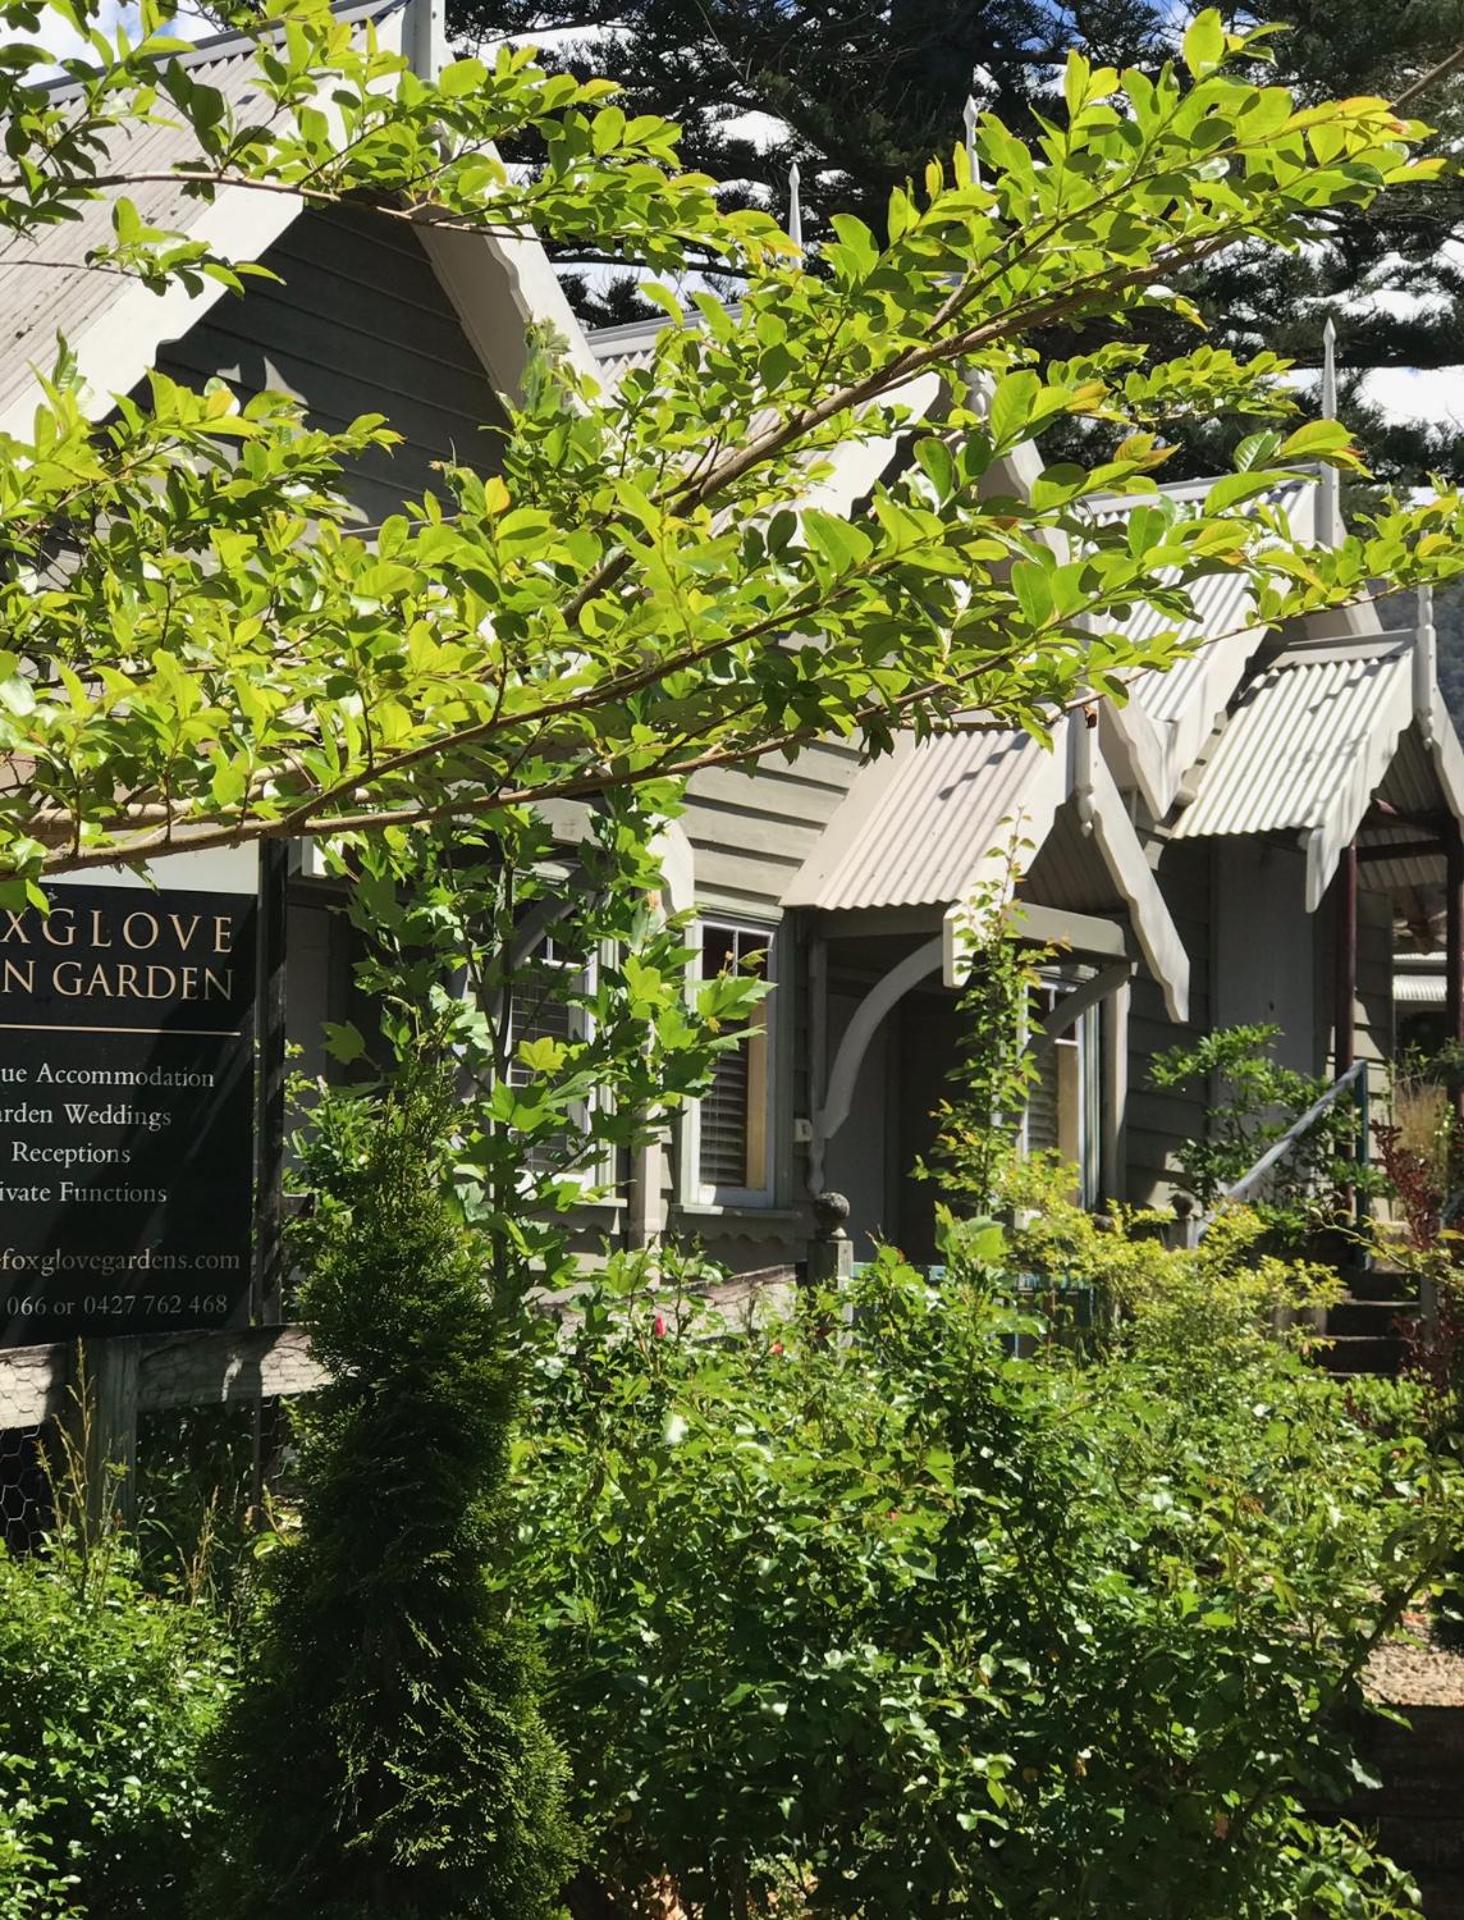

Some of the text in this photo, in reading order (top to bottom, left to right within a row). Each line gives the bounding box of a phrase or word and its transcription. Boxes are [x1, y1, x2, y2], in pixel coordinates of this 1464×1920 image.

[0, 906, 233, 953] XGLOVE
[1, 959, 233, 1001] N GARDEN
[1, 1062, 215, 1088] ue Accommodation
[0, 1102, 172, 1132] rden Weddings
[11, 1141, 131, 1168] Receptions
[59, 1181, 167, 1203] Functions
[0, 1248, 240, 1277] foxglovegardens.com
[7, 1294, 228, 1316] 066 or 0427 762 468
